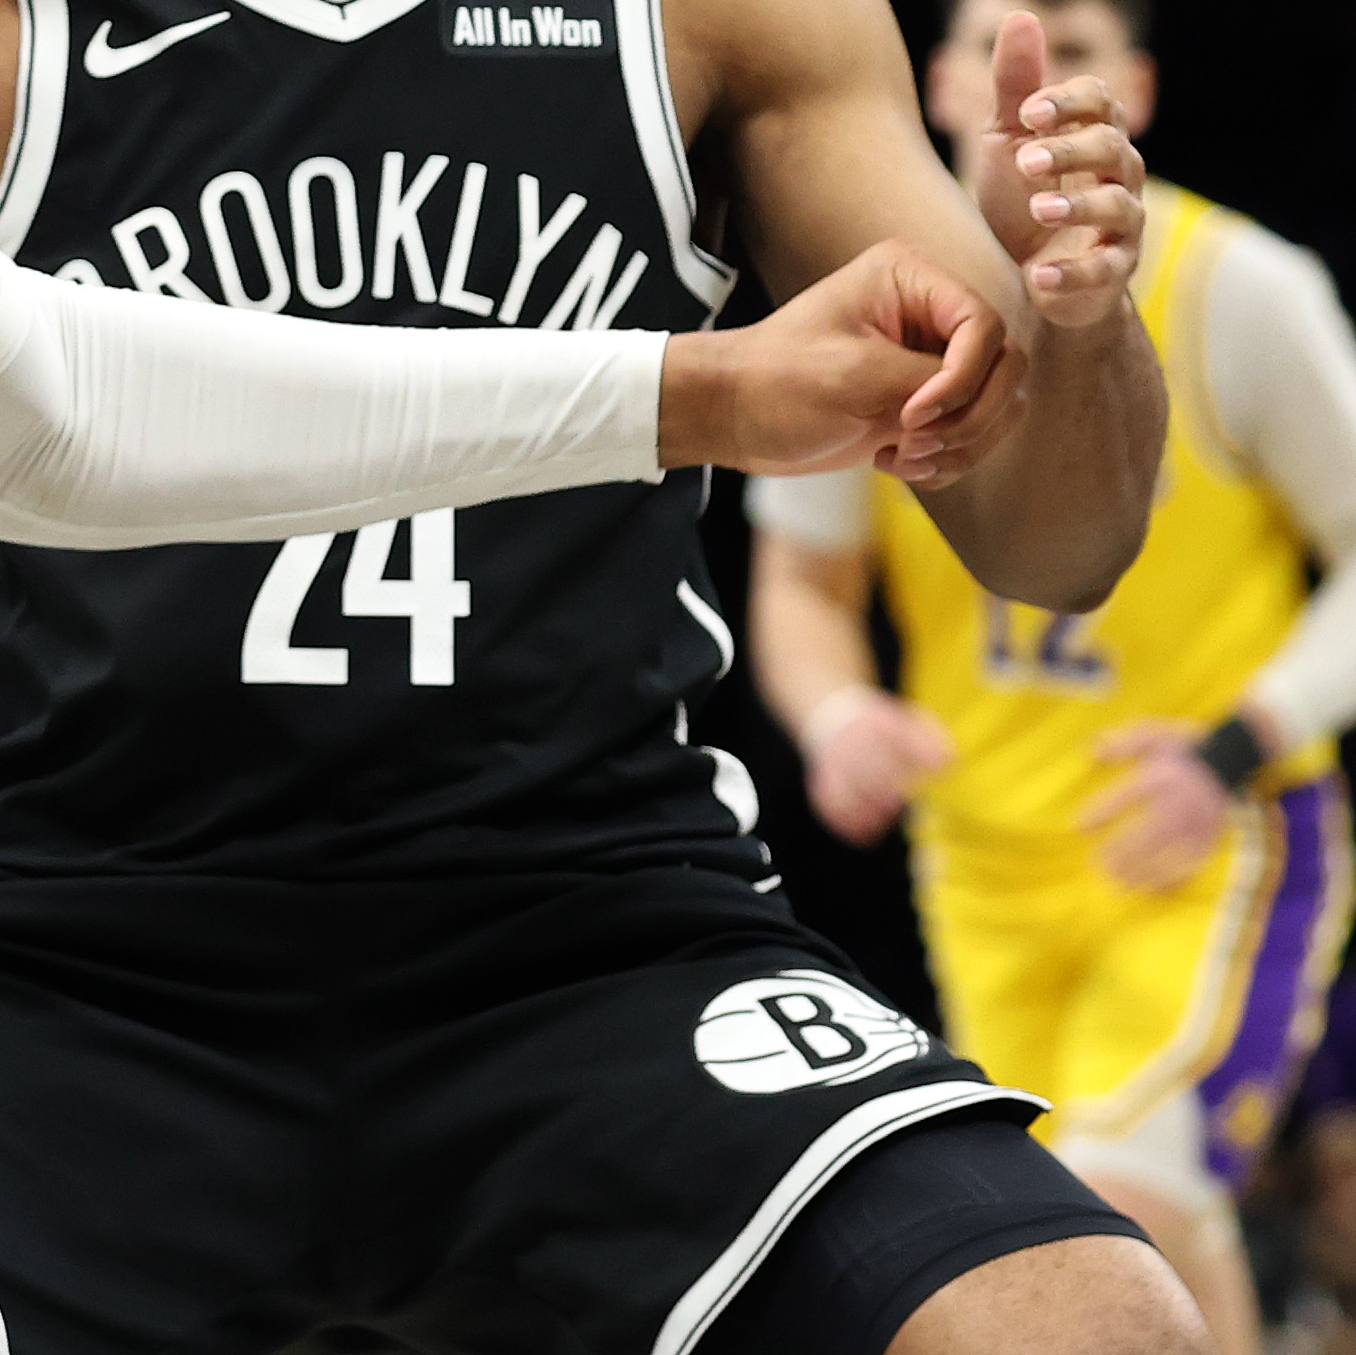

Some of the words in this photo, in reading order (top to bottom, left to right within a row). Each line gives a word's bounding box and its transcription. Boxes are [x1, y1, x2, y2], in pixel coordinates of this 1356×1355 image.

[453, 6, 495, 46] All
[498, 6, 532, 46] In
[532, 6, 602, 47] Won
[52, 151, 650, 331] ROOKLYN
[757, 991, 868, 1070] B
